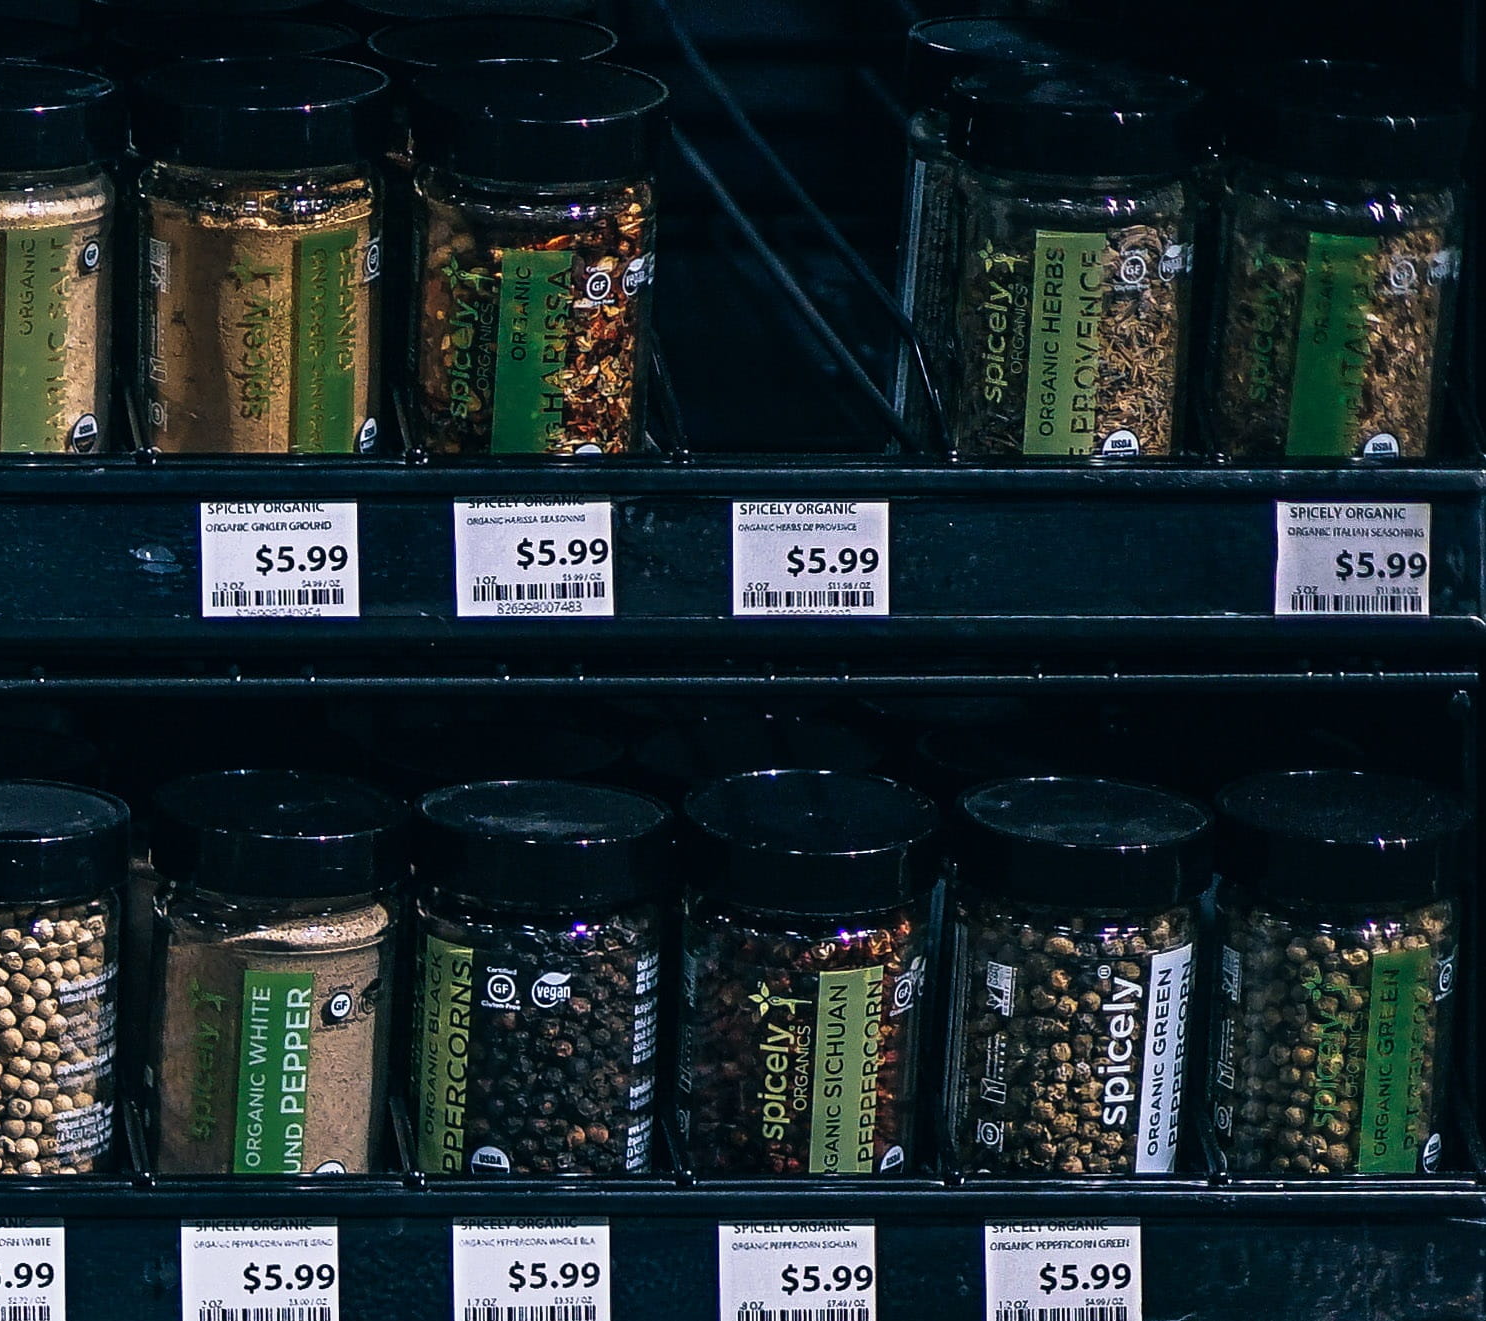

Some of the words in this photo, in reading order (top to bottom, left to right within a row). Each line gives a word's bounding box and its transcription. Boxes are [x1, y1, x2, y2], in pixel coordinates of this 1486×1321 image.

[1044, 247, 1065, 332] HERBS
[1040, 339, 1057, 436] ORGANIC
[1336, 550, 1427, 581] $5.99
[281, 986, 312, 1118] PEPPER
[1154, 967, 1174, 1058] GREEN
[855, 978, 884, 1163] PEPPERCORN
[1145, 1062, 1166, 1157] ORGANIC
